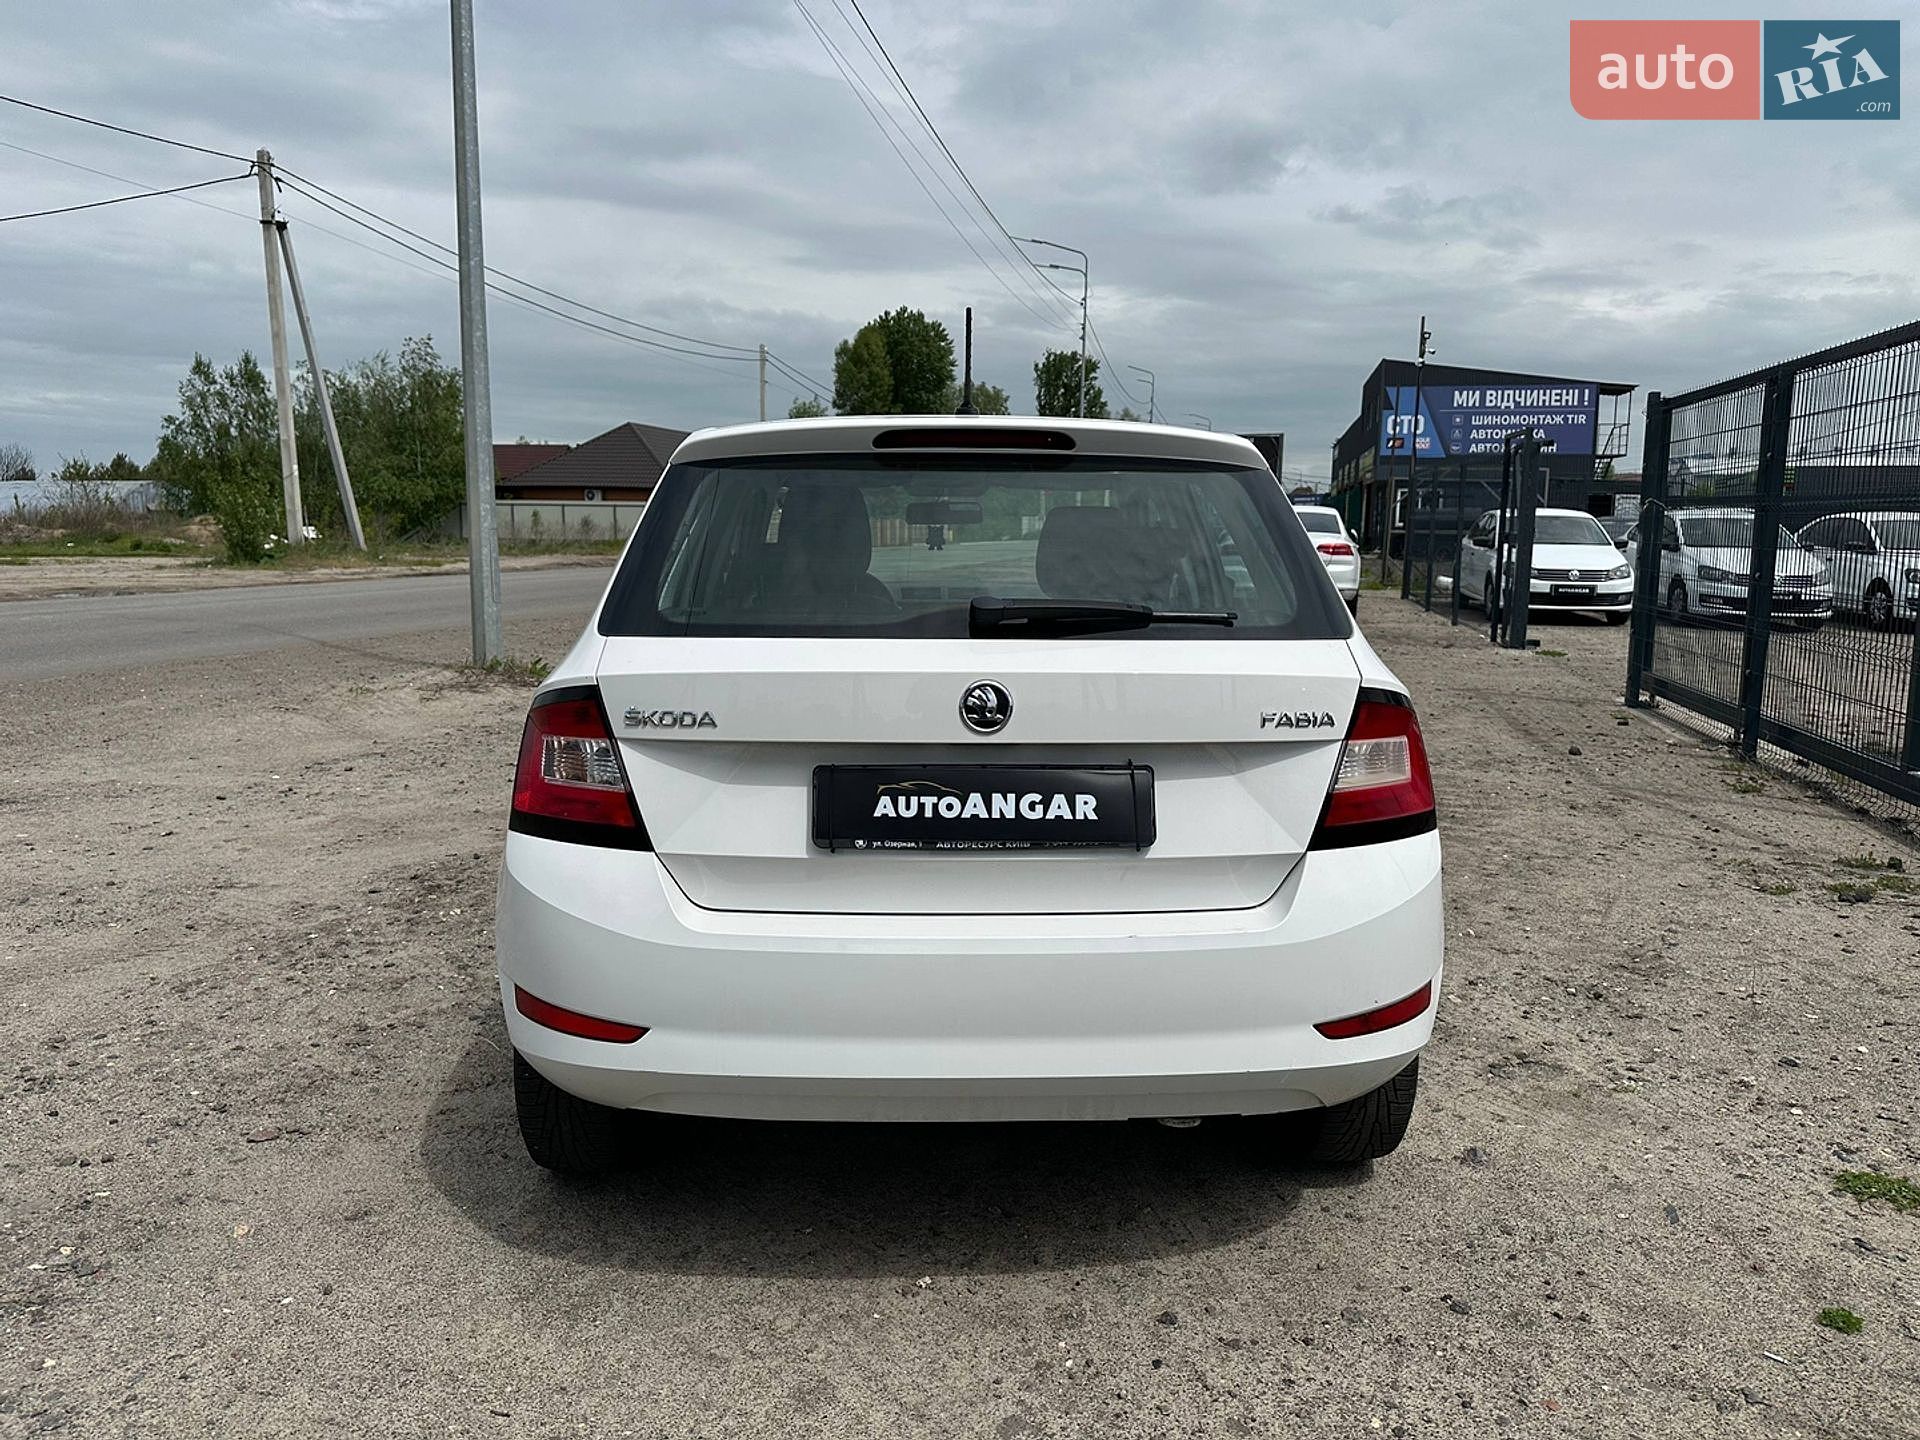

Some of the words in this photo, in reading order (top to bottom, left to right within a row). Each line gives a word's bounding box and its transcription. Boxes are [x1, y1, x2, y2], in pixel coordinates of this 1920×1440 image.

[1453, 390, 1480, 407] МИ
[1485, 389, 1579, 409] ВІДЧИНЕНІ
[1583, 389, 1589, 406] !
[1387, 414, 1425, 435] СТО
[1471, 414, 1564, 426] ШИНОМОНТАЖ
[1567, 414, 1587, 425] TIR
[624, 705, 718, 729] ŠKODA
[1260, 711, 1335, 729] FABIA
[873, 793, 1098, 821] AUTOANGAR
